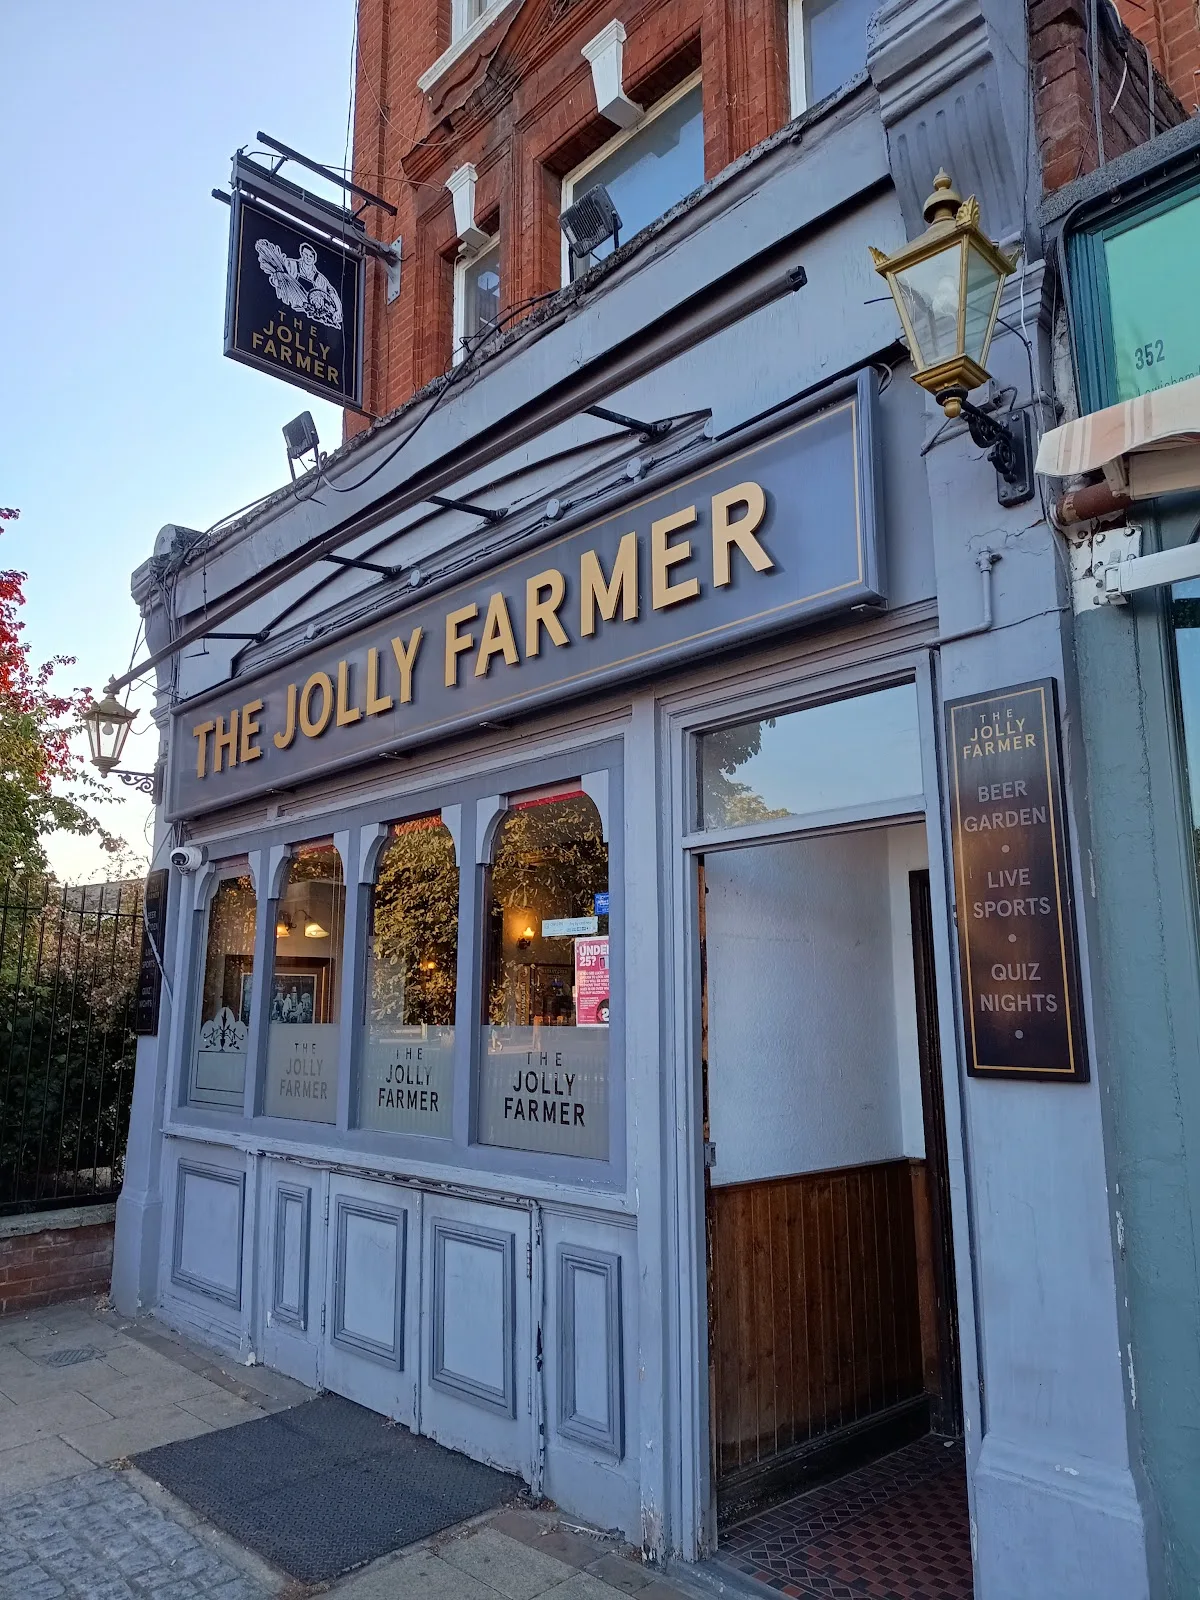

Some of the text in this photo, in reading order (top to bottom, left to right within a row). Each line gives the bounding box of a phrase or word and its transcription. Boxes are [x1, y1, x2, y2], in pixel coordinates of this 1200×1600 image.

[278, 310, 317, 337] THE
[263, 320, 330, 360] JOLLY
[252, 332, 339, 385] FARMER
[1134, 339, 1166, 371] 352
[192, 481, 774, 780] THE JOLLY FARMER
[980, 708, 1013, 724] THE
[970, 718, 1026, 742] JOLLY
[963, 733, 1037, 760] FARMER
[978, 780, 1028, 803] BEER
[963, 806, 1047, 833] GARDEN
[987, 867, 1031, 889] LIVE
[973, 896, 1051, 919] SPORTS
[579, 955, 597, 967] 25?
[991, 962, 1042, 981] QUIZ
[980, 993, 1058, 1012] NIGHTS
[294, 1042, 317, 1055] THE
[396, 1047, 424, 1060] THE
[526, 1051, 564, 1067] THE
[285, 1058, 324, 1078] JOLLY
[385, 1064, 434, 1087] JOLLY
[279, 1078, 328, 1100] FARMER
[512, 1070, 577, 1097] JOLLY
[377, 1087, 440, 1113] FARMER
[503, 1097, 586, 1128] FARMER
